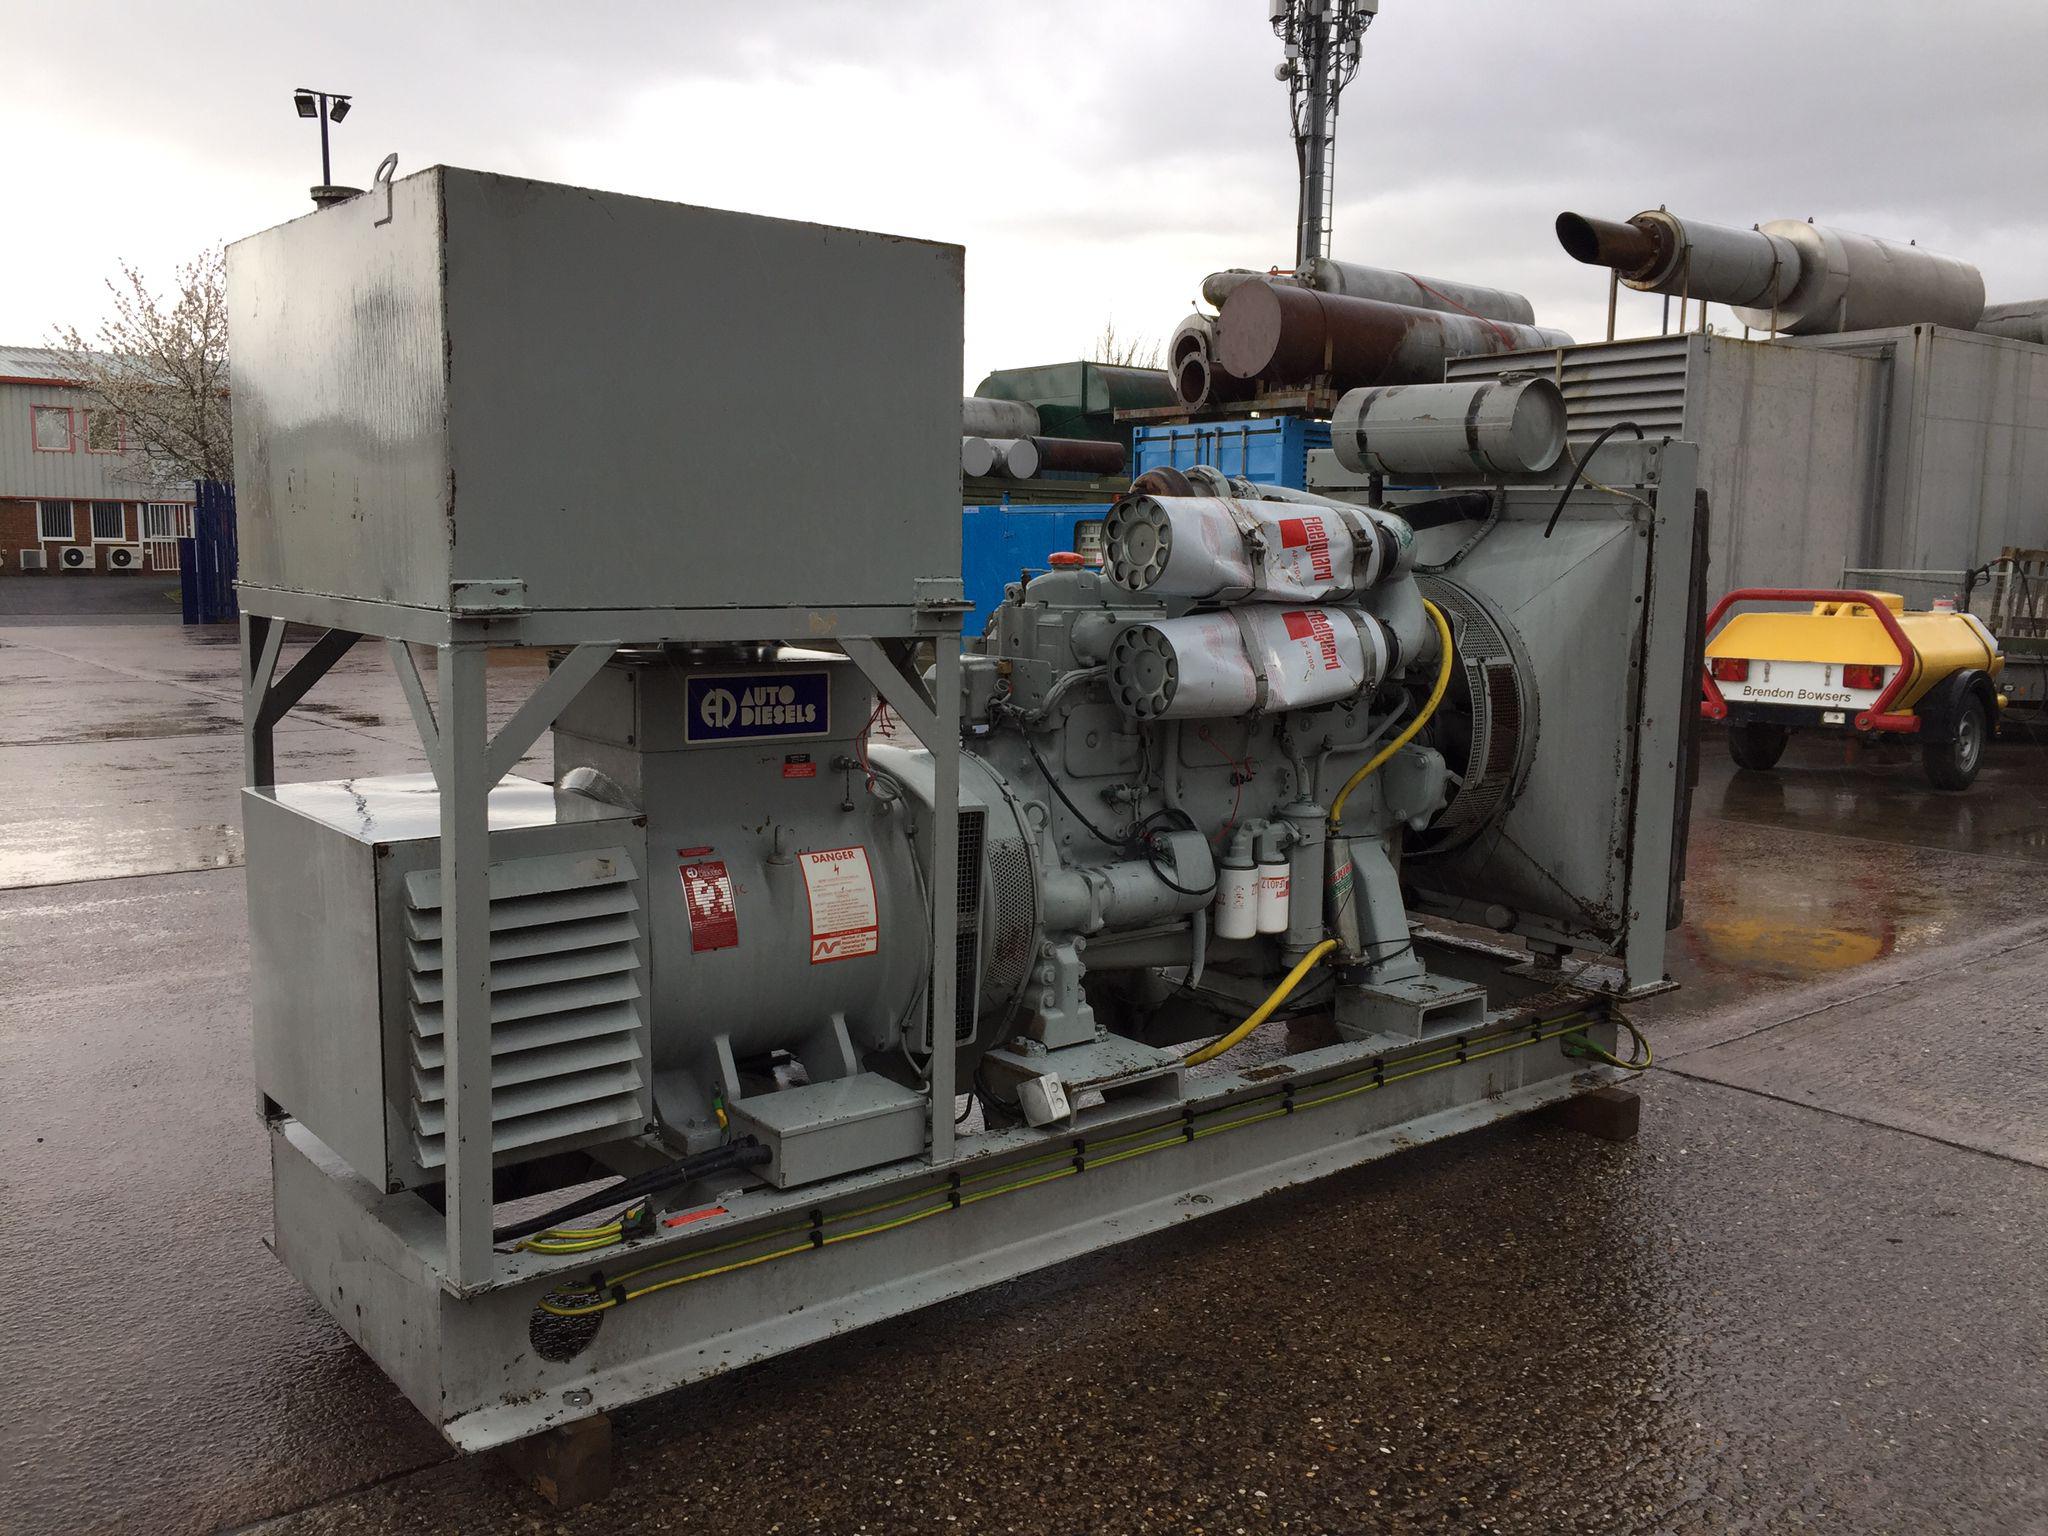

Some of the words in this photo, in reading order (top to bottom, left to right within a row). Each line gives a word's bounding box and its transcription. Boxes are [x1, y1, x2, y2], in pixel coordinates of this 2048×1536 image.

[1302, 516, 1334, 581] Fleetguard
[1305, 609, 1341, 671] Fleetguard
[741, 685, 795, 705] AUTO
[1743, 686, 1794, 699] Brendon
[1797, 689, 1852, 703] Bowsers
[741, 704, 816, 726] DIESELS
[811, 850, 856, 864] DANGER
